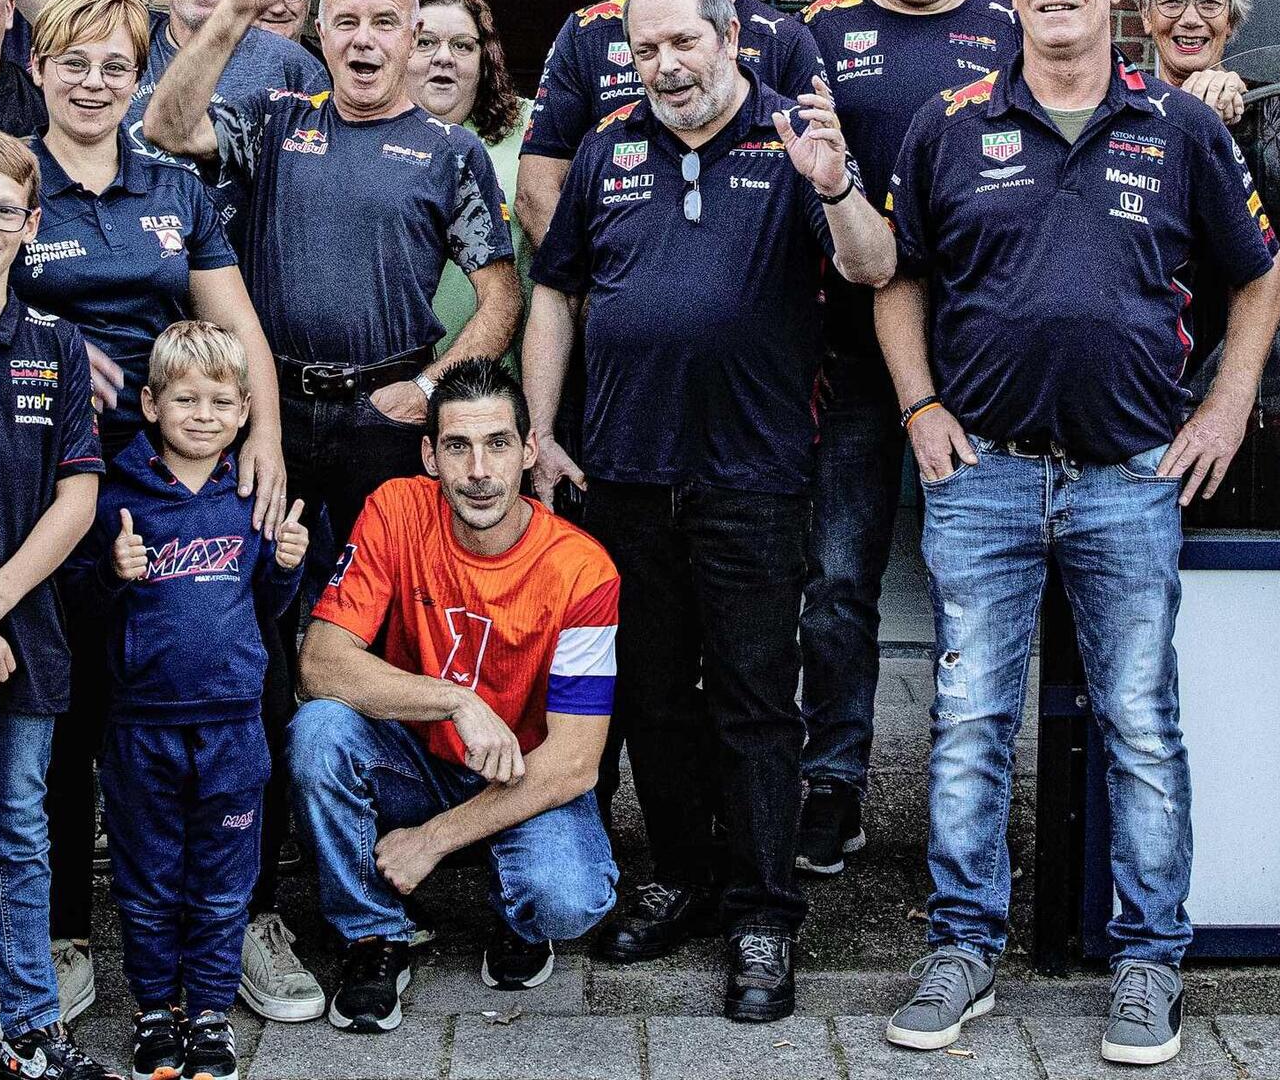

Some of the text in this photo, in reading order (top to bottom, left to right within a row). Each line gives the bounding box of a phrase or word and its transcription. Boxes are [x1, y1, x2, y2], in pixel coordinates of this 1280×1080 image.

[837, 57, 870, 72] Mobil
[600, 72, 632, 87] Mobil
[837, 67, 883, 83] ORACLE
[600, 87, 646, 100] ORACLE
[984, 132, 1018, 144] TAG
[1110, 131, 1167, 146] ASTON MARTIN
[618, 144, 646, 154] TAG
[729, 150, 785, 158] RACING
[983, 145, 1021, 161] HEUER
[614, 153, 647, 169] HEUER
[1108, 149, 1164, 165] RACING
[604, 176, 639, 192] Mobil
[741, 178, 770, 189] Tezos
[975, 178, 1035, 193] ASTON MARTIN
[1105, 168, 1147, 189] Mobil
[603, 191, 652, 204] ORACLE
[1108, 208, 1149, 224] HONDA
[26, 239, 80, 254] HANSEN
[25, 247, 87, 266] DRANKEN
[10, 360, 58, 370] ORACLE
[12, 380, 58, 388] RACING
[17, 393, 53, 411] BYBIT
[15, 415, 53, 426] HONDA
[145, 538, 244, 579] MAX
